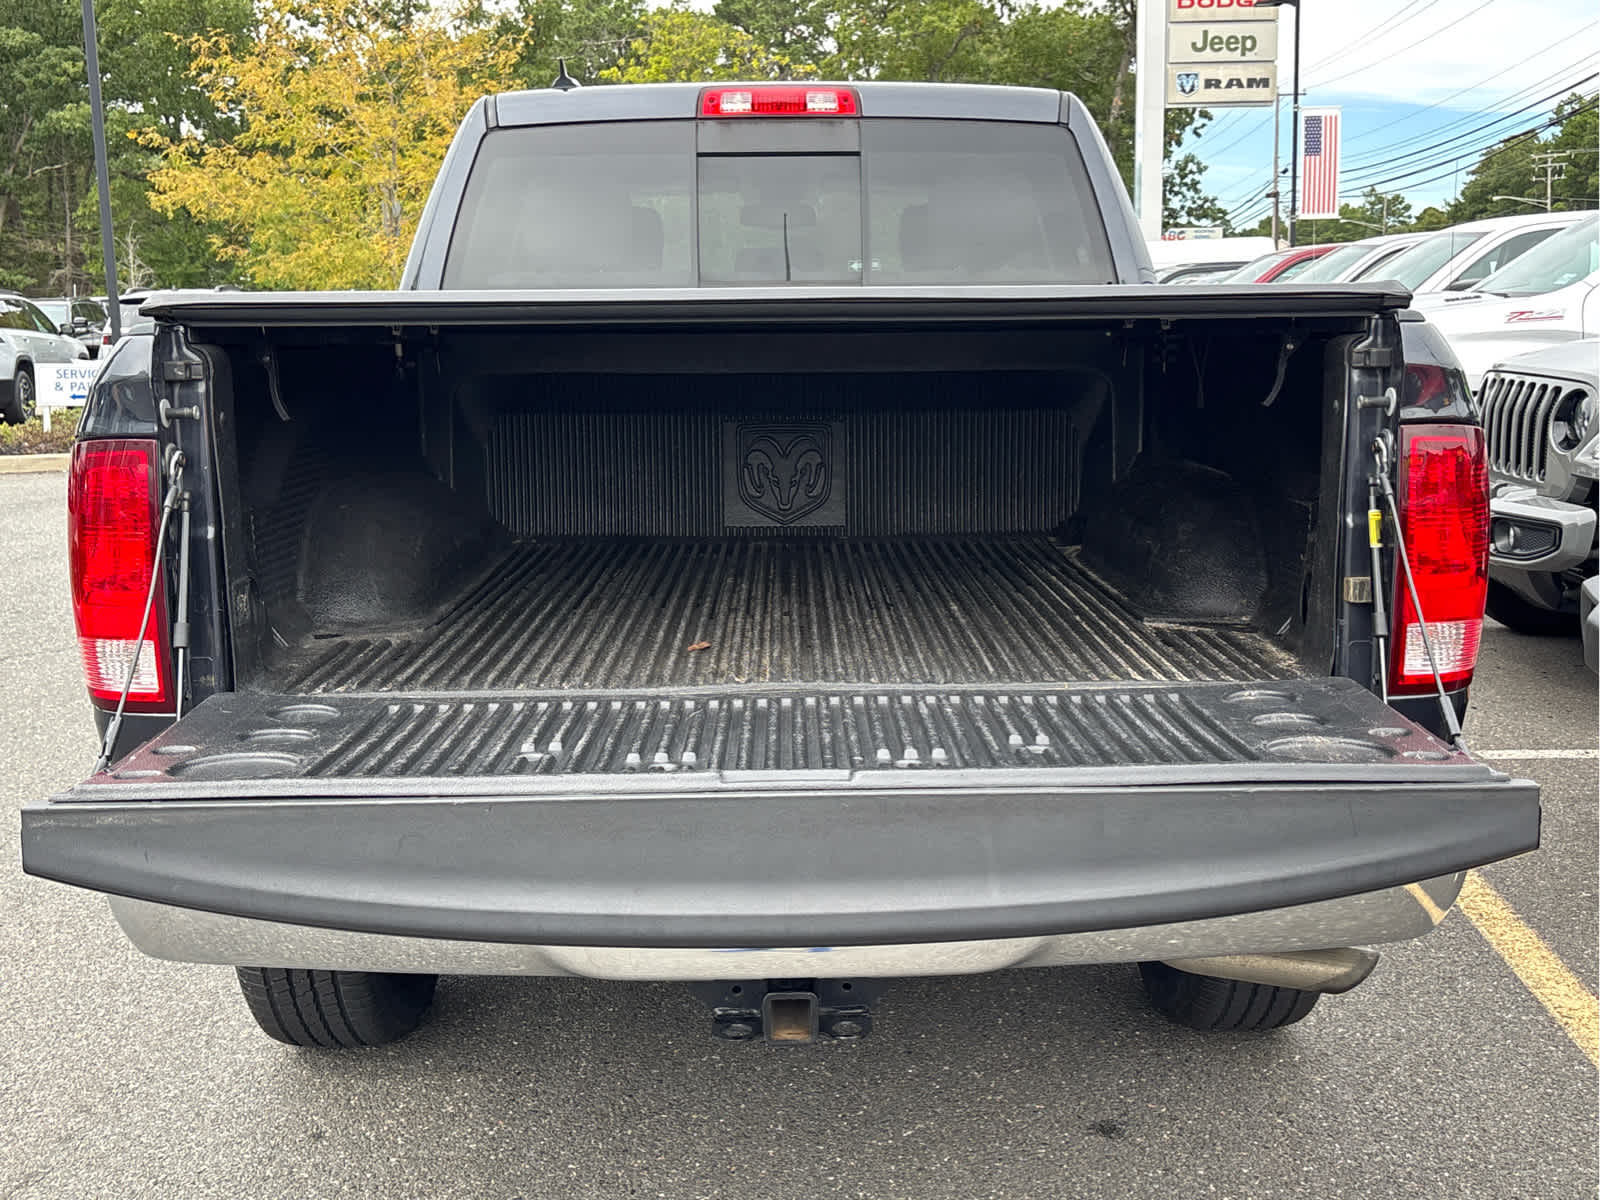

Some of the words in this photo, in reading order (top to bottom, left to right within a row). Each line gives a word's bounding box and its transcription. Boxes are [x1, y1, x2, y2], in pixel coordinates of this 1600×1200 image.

[1177, 0, 1262, 9] DODG
[1191, 29, 1257, 57] Jeep
[1204, 77, 1270, 90] RAM
[55, 381, 64, 392] &
